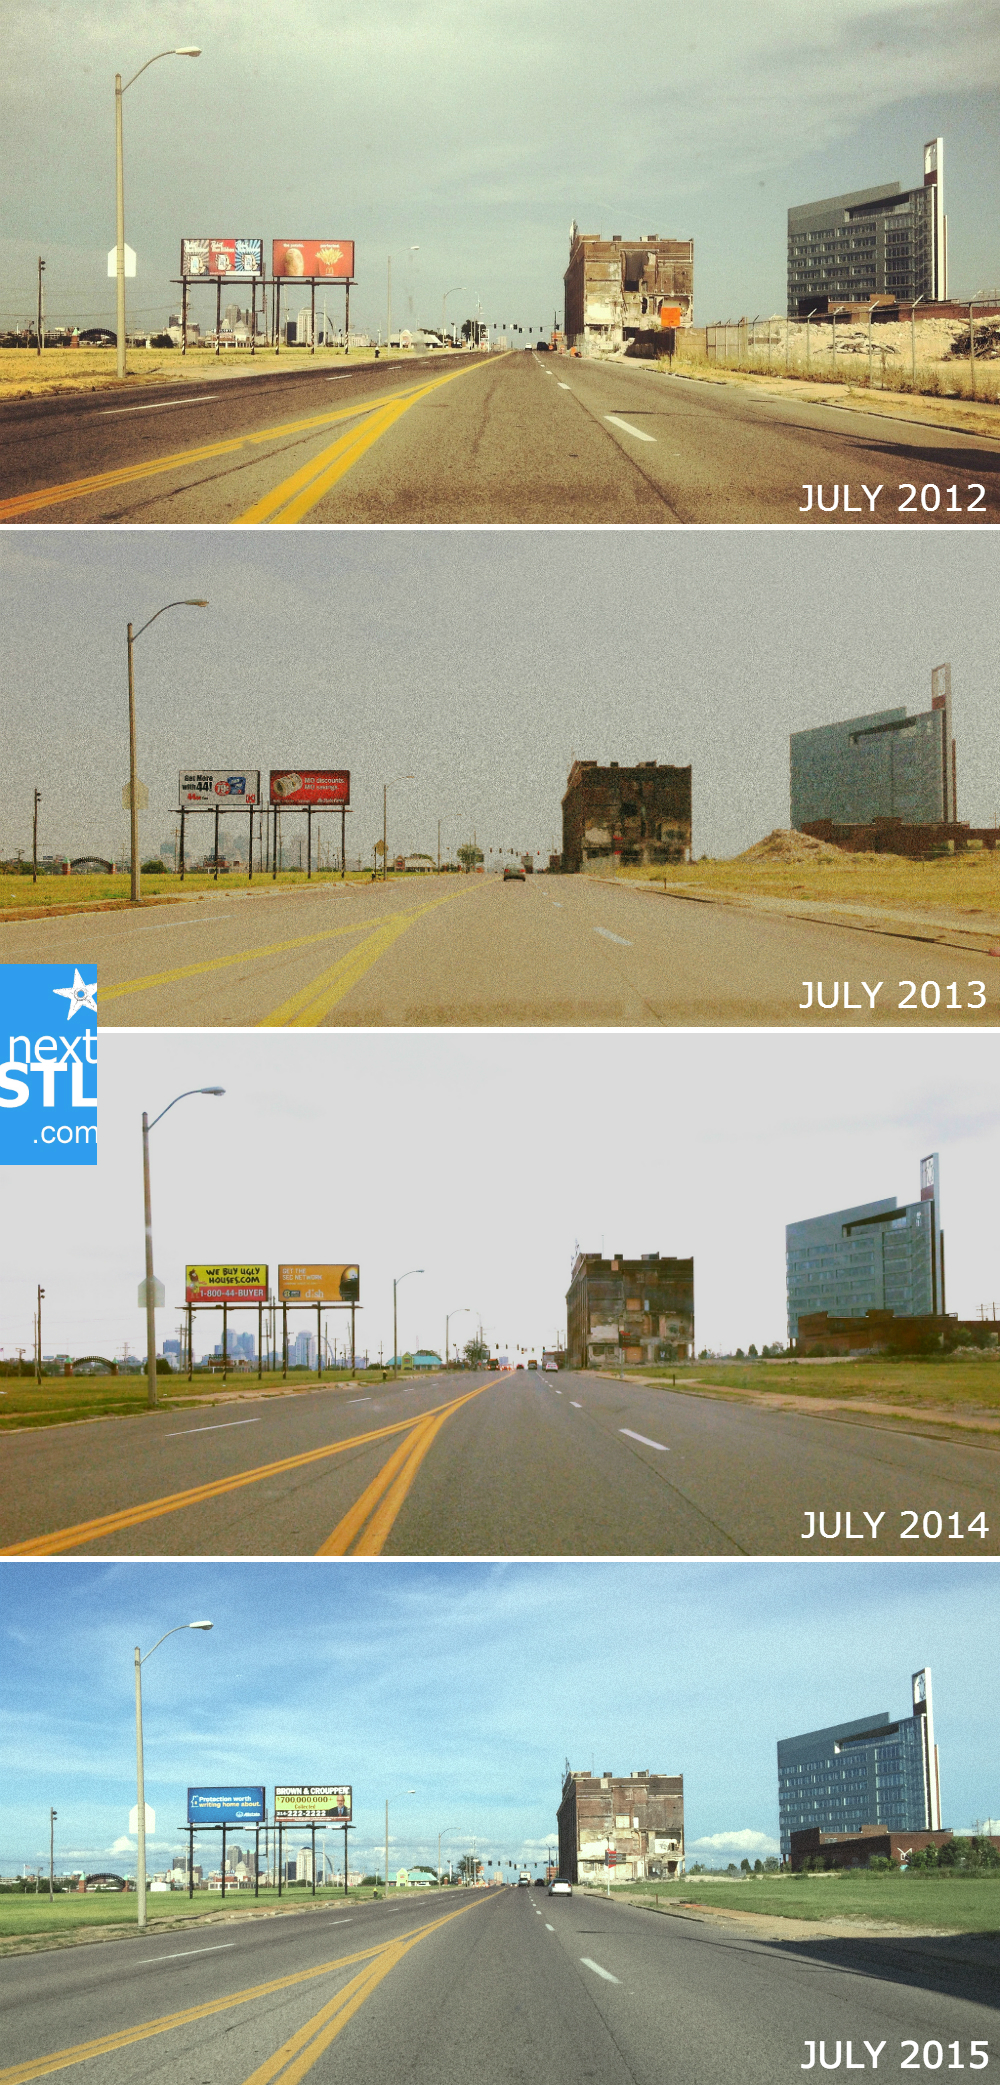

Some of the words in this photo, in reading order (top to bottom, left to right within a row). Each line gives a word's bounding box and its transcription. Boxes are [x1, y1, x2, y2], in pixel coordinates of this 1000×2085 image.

[223, 1267, 238, 1276] BUY
[240, 1267, 260, 1276] UGLY
[208, 1276, 260, 1284] HOUSES.COM
[200, 1289, 264, 1297] 1-800-44-BUYER
[276, 1787, 302, 1795] BROWN
[302, 1787, 310, 1795] &
